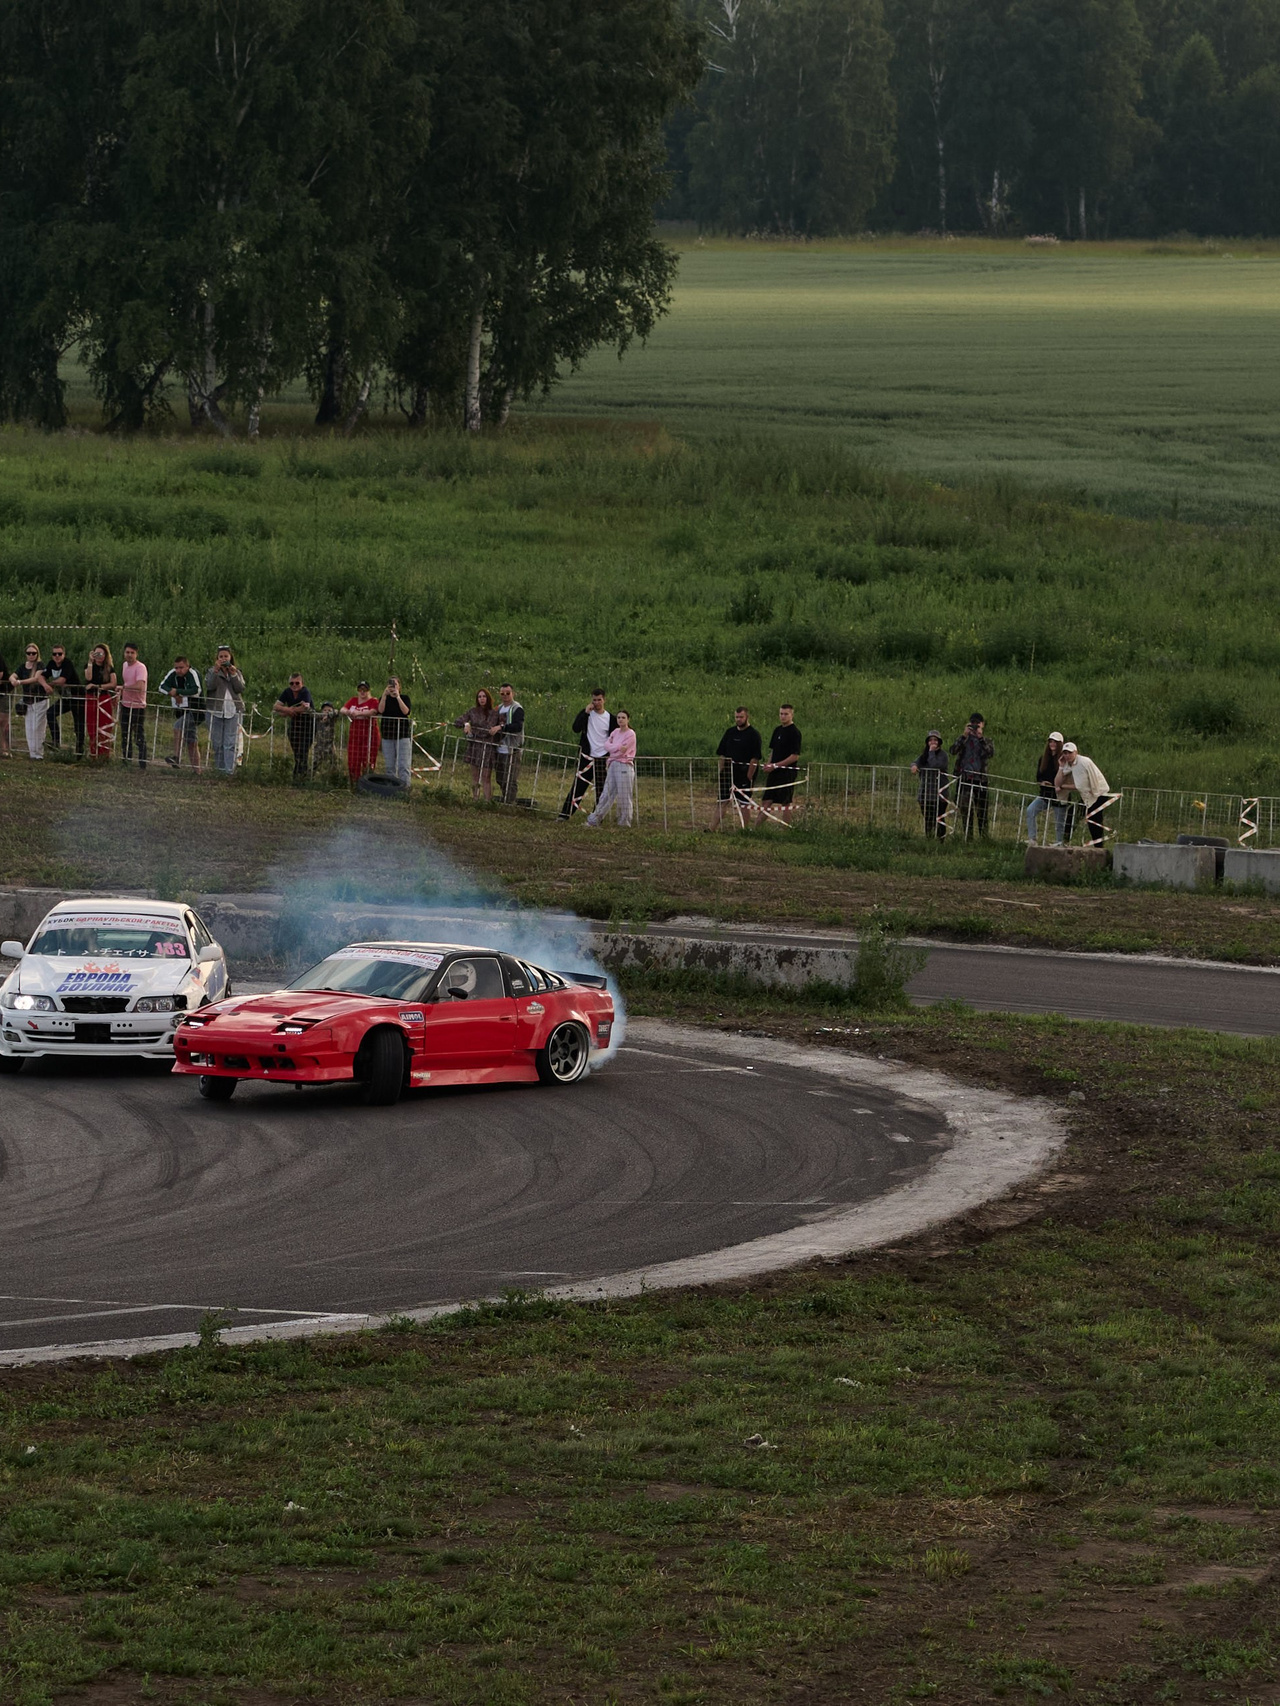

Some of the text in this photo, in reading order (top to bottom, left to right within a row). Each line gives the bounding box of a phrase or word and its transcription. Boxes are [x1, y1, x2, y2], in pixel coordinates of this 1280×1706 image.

[145, 919, 179, 928] РАКЕТЫ
[155, 942, 186, 956] 133
[64, 973, 131, 983] ЕВРОПА
[56, 983, 138, 992] БОУЛИНГ
